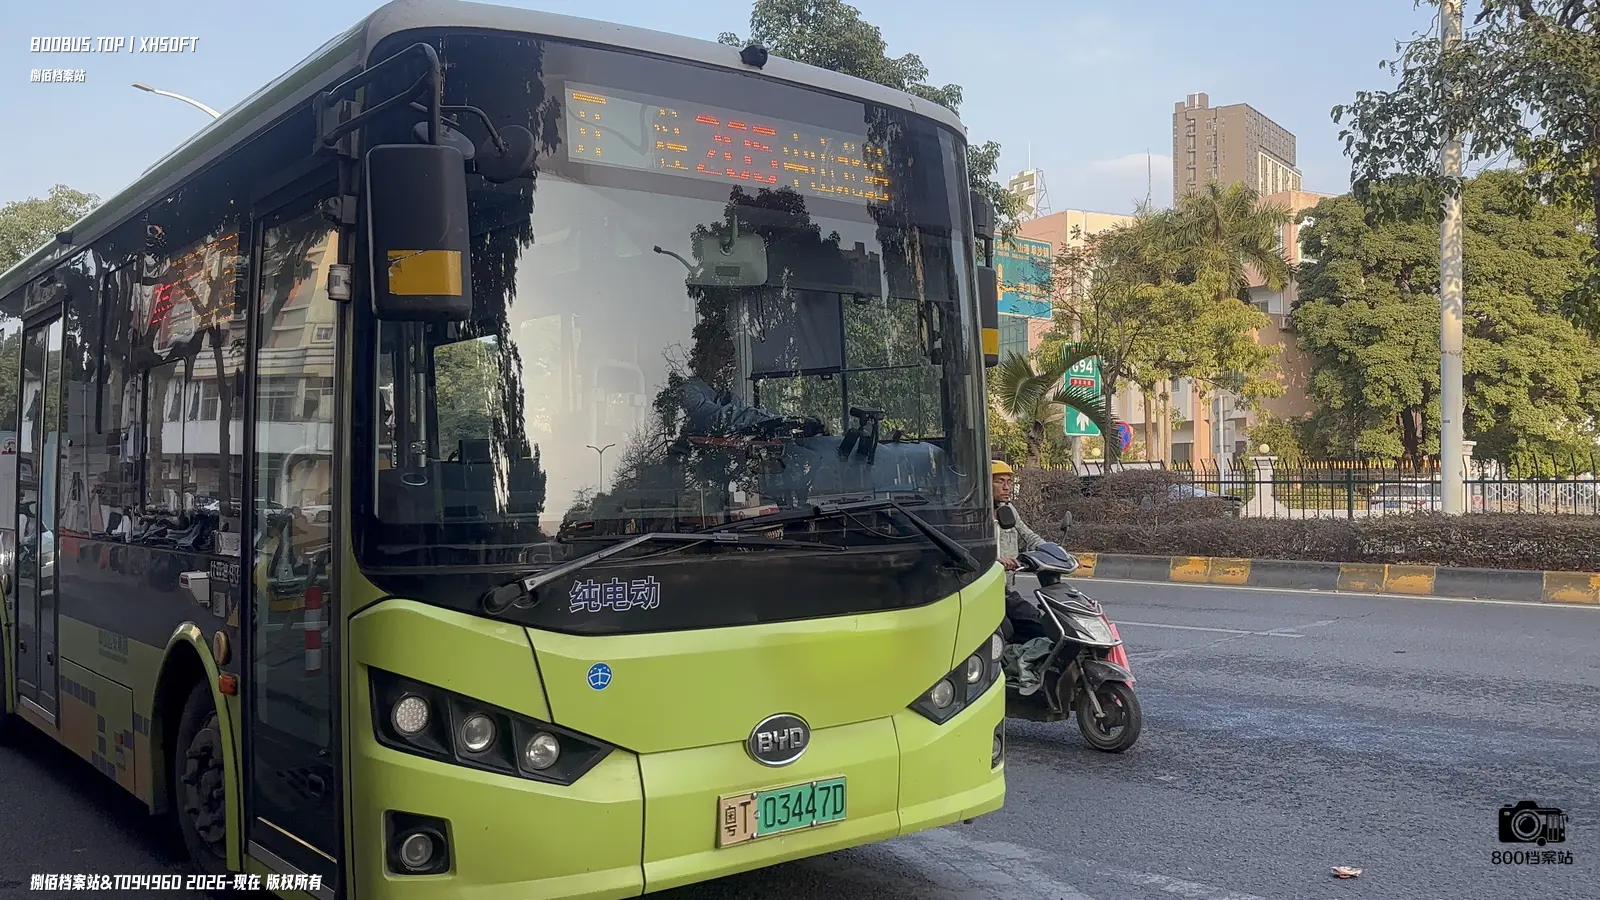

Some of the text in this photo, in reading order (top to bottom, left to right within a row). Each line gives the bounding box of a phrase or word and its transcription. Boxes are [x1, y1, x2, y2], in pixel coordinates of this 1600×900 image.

[569, 575, 661, 613] 纯电动
[758, 727, 804, 753] BYD
